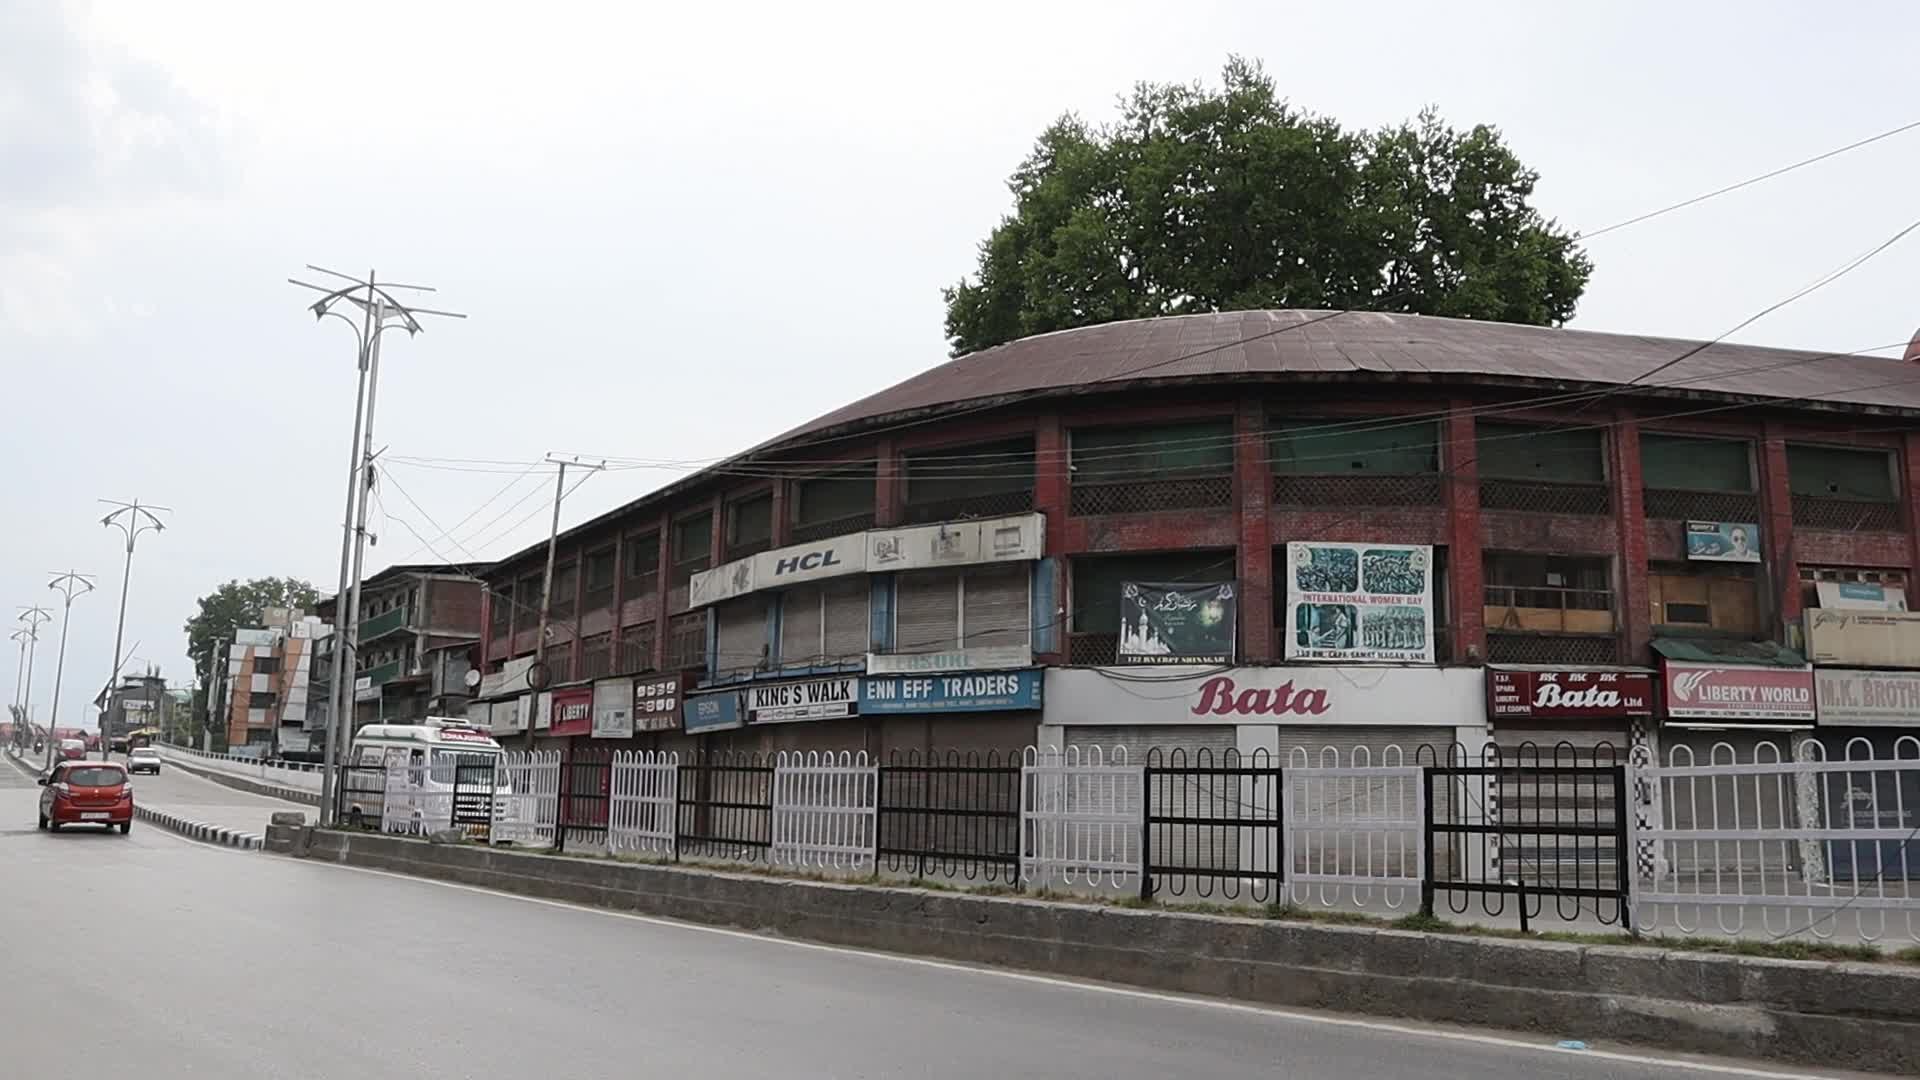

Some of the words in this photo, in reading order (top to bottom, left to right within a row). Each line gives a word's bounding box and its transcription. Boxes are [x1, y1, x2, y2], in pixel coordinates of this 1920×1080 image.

[775, 549, 841, 575] HCL
[1303, 593, 1367, 604] INTERNATIONAL
[1406, 597, 1424, 605] DAY
[756, 685, 802, 707] KING'S
[807, 680, 850, 703] WALK
[867, 680, 896, 699] ENN
[903, 678, 933, 698] EFF
[942, 675, 1019, 697] TRADERS
[1191, 676, 1331, 715] Bata
[1532, 683, 1621, 708] Bata
[1698, 685, 1757, 701] LIBERTY
[1760, 687, 1809, 703] WORLD
[562, 703, 589, 721] LIBERTY
